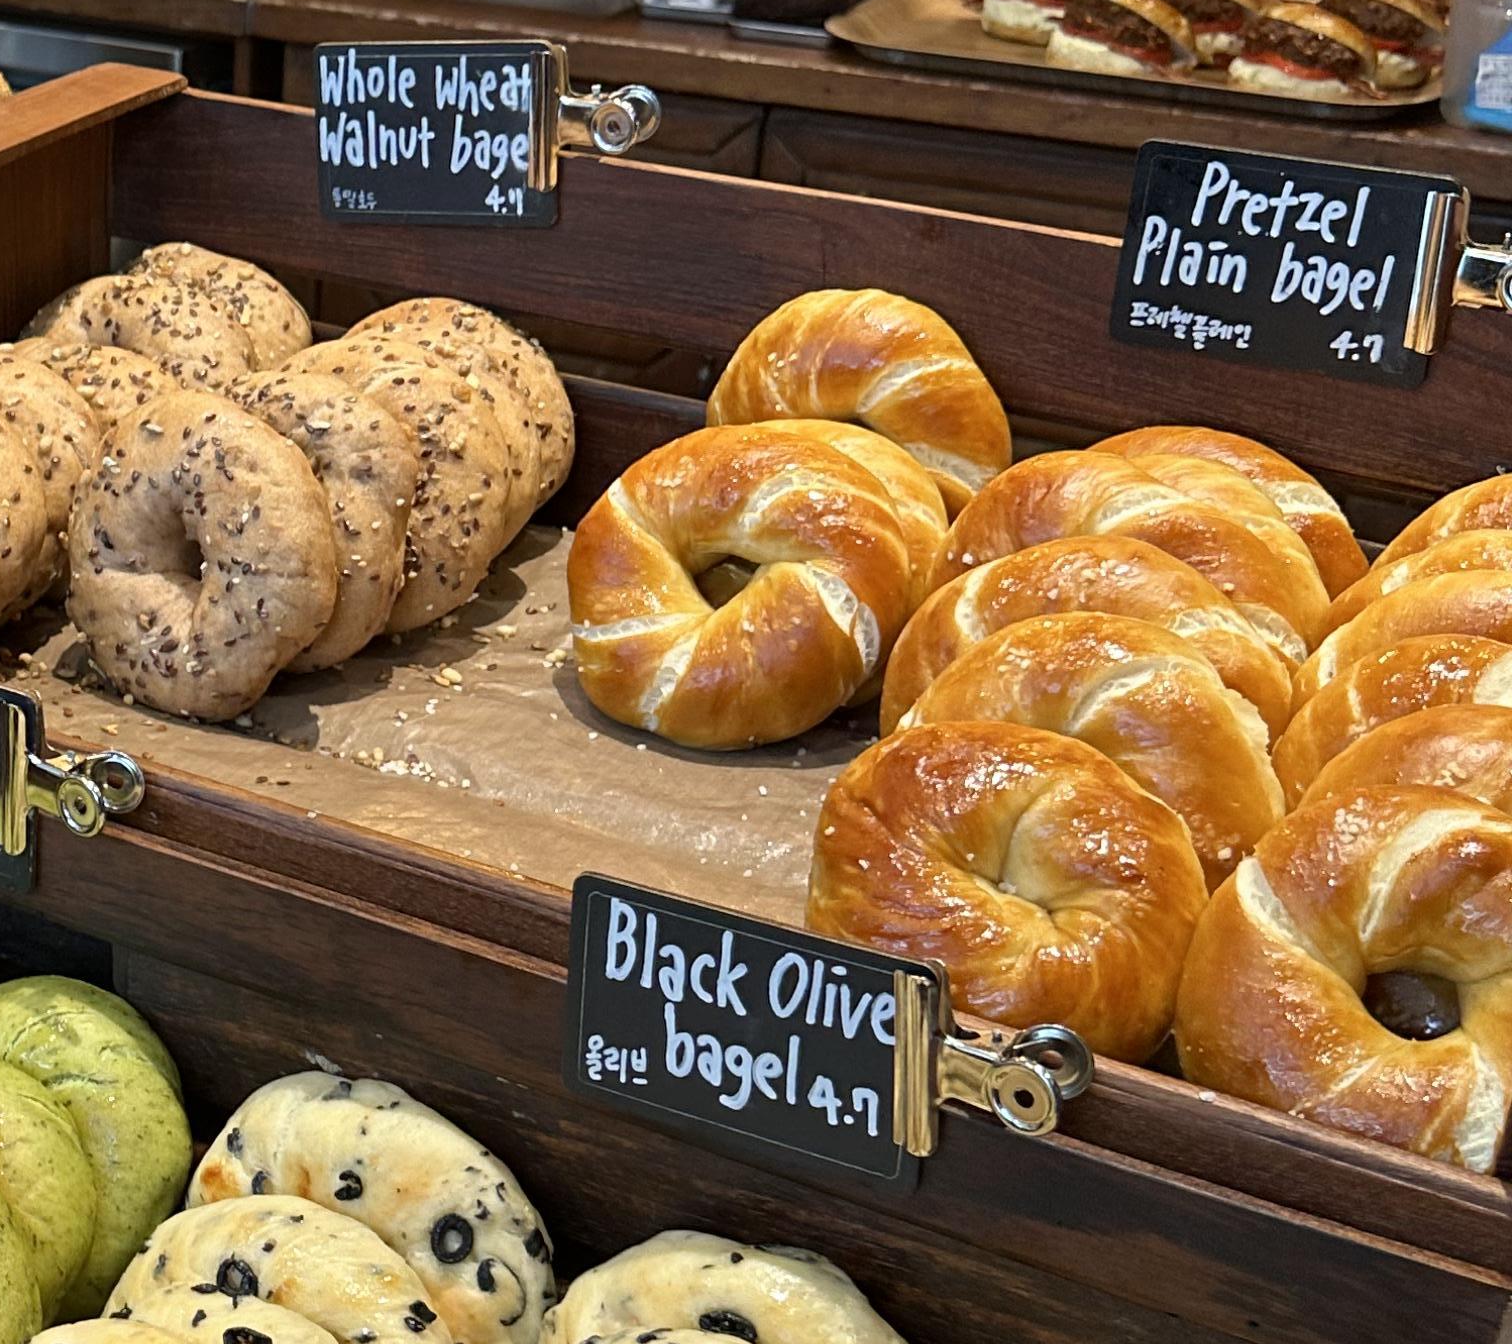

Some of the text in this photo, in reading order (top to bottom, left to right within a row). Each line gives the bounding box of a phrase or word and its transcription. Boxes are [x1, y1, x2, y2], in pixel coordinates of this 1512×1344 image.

[319, 47, 417, 109] Whole
[449, 113, 530, 180] bage
[1190, 160, 1372, 248] Pretzel
[1132, 215, 1396, 316] Plain bagel
[1329, 330, 1385, 364] 4.7
[605, 896, 896, 1046] Black Olive
[584, 1034, 649, 1086] 올리브
[663, 1002, 880, 1137] bagel 4.7
